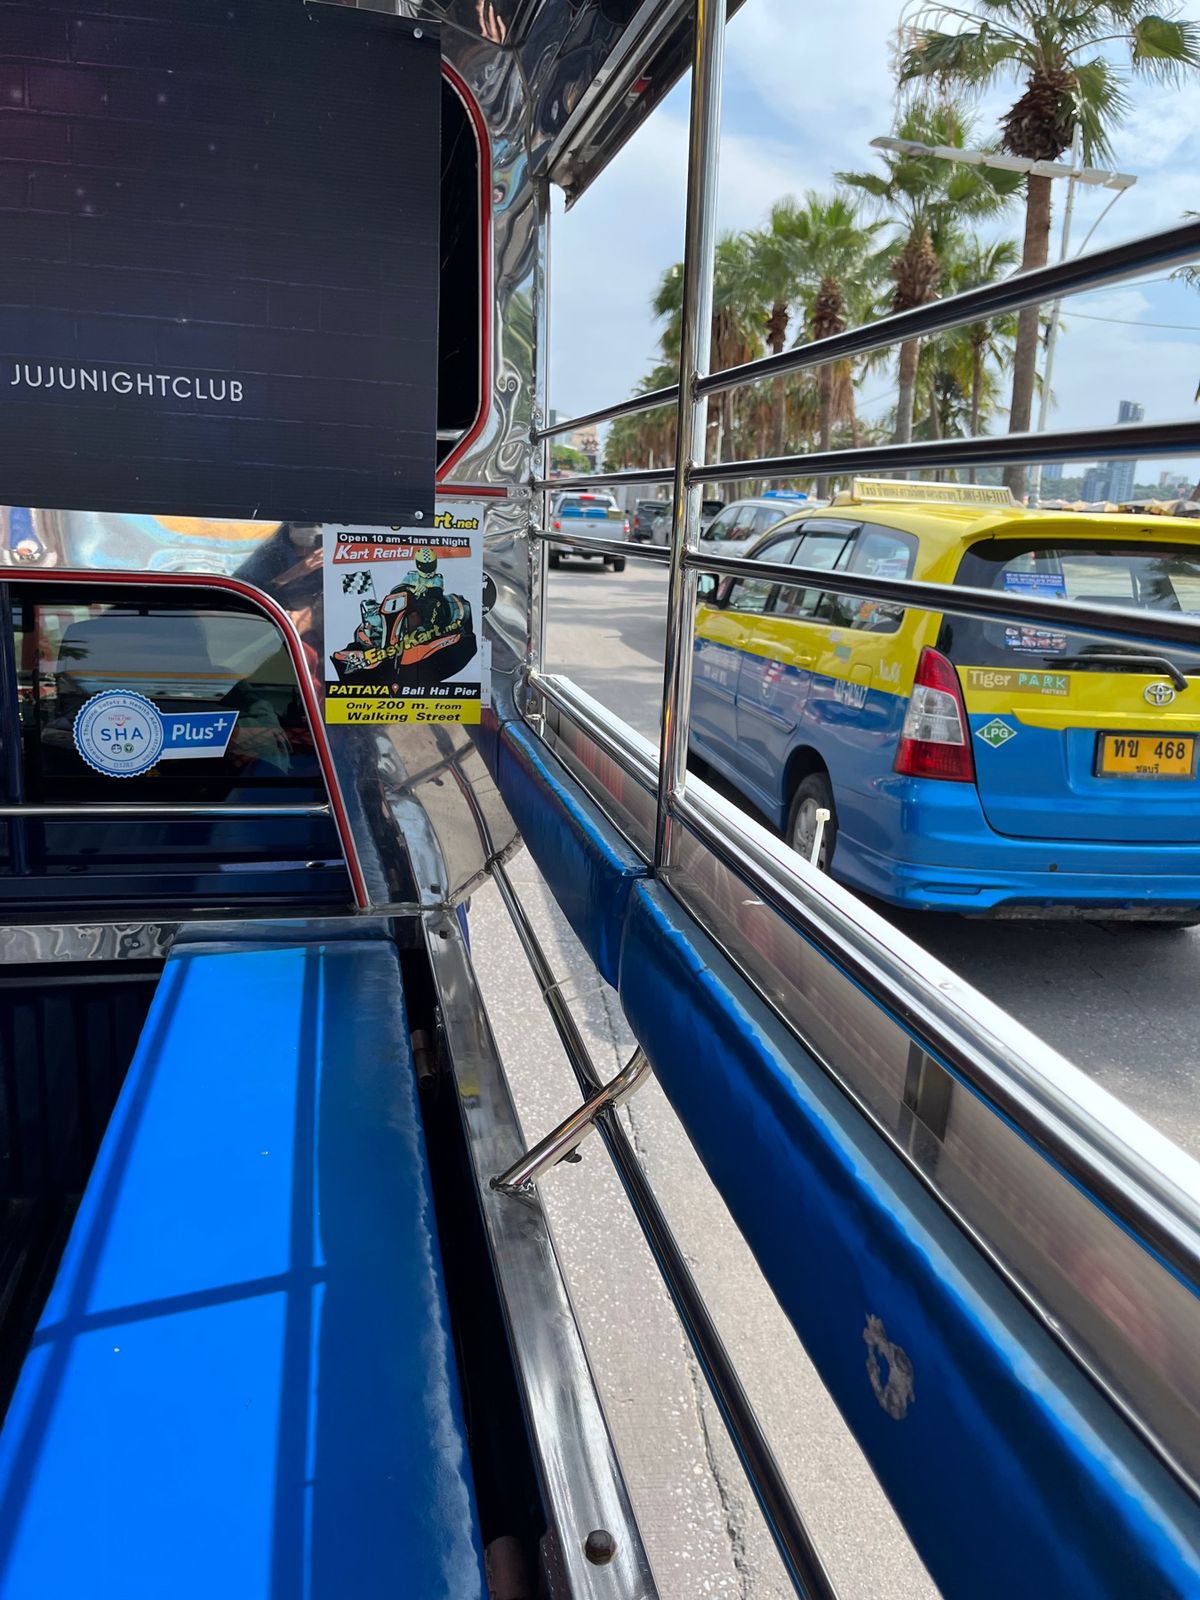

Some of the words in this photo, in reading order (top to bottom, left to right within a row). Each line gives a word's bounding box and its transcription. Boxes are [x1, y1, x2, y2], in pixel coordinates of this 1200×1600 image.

[10, 364, 244, 402] JUJUNIGHTCLUB
[434, 511, 479, 529] rt.net
[339, 533, 368, 544] Open
[372, 535, 383, 543] 10
[430, 537, 440, 545] at
[441, 537, 468, 547] Night
[335, 544, 369, 560] Kart
[373, 546, 413, 559] Rental
[391, 599, 397, 610] 1
[364, 619, 462, 664] EasyKart.net
[969, 670, 1011, 688] Tiger
[1018, 673, 1066, 689] PARK
[328, 685, 390, 695] PATTAYA
[402, 686, 424, 695] Bali
[429, 686, 449, 695] Hai
[454, 687, 477, 696] Pier
[346, 702, 372, 711] Only
[377, 701, 405, 710] 200
[411, 702, 429, 710] m.
[435, 702, 462, 710] from
[347, 712, 408, 722] Walking
[416, 712, 461, 721] Street
[101, 727, 144, 742] SHA
[984, 728, 1008, 738] LPG
[1154, 741, 1185, 760] 468
